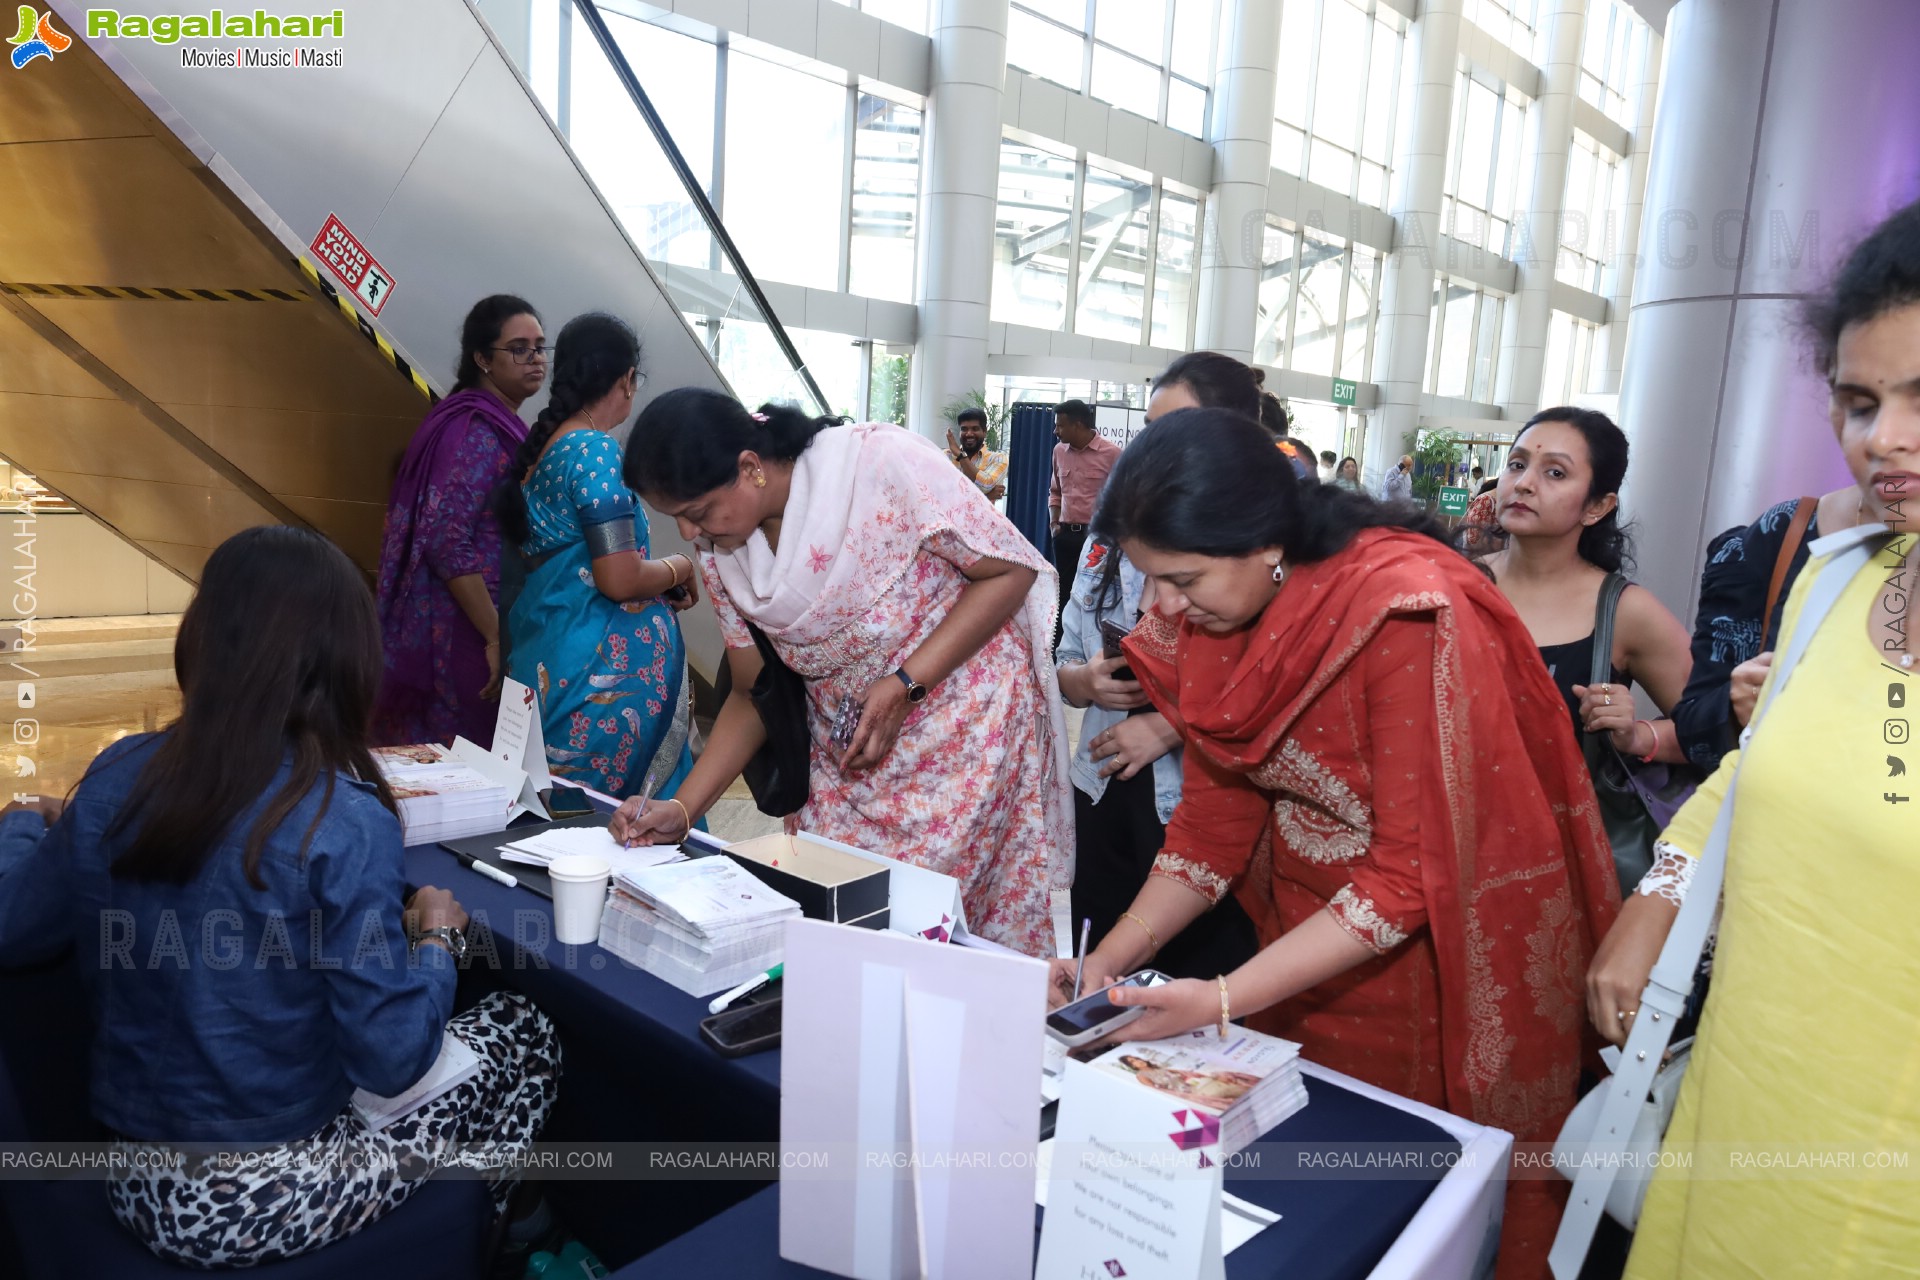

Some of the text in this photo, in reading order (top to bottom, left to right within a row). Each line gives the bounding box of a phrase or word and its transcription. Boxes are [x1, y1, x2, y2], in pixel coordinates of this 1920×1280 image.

[318, 242, 357, 284] HEAD
[325, 231, 363, 277] YOUR
[330, 224, 367, 265] MIND
[1334, 383, 1355, 400] EXIT
[1111, 428, 1124, 438] NO
[1441, 492, 1467, 503] EXIT
[1073, 1204, 1087, 1219] for
[1088, 1215, 1105, 1231] any
[1106, 1222, 1125, 1241] loss
[1126, 1235, 1146, 1251] and
[1089, 1189, 1105, 1203] are
[1105, 1198, 1122, 1211] not
[1123, 1206, 1178, 1239] responsible
